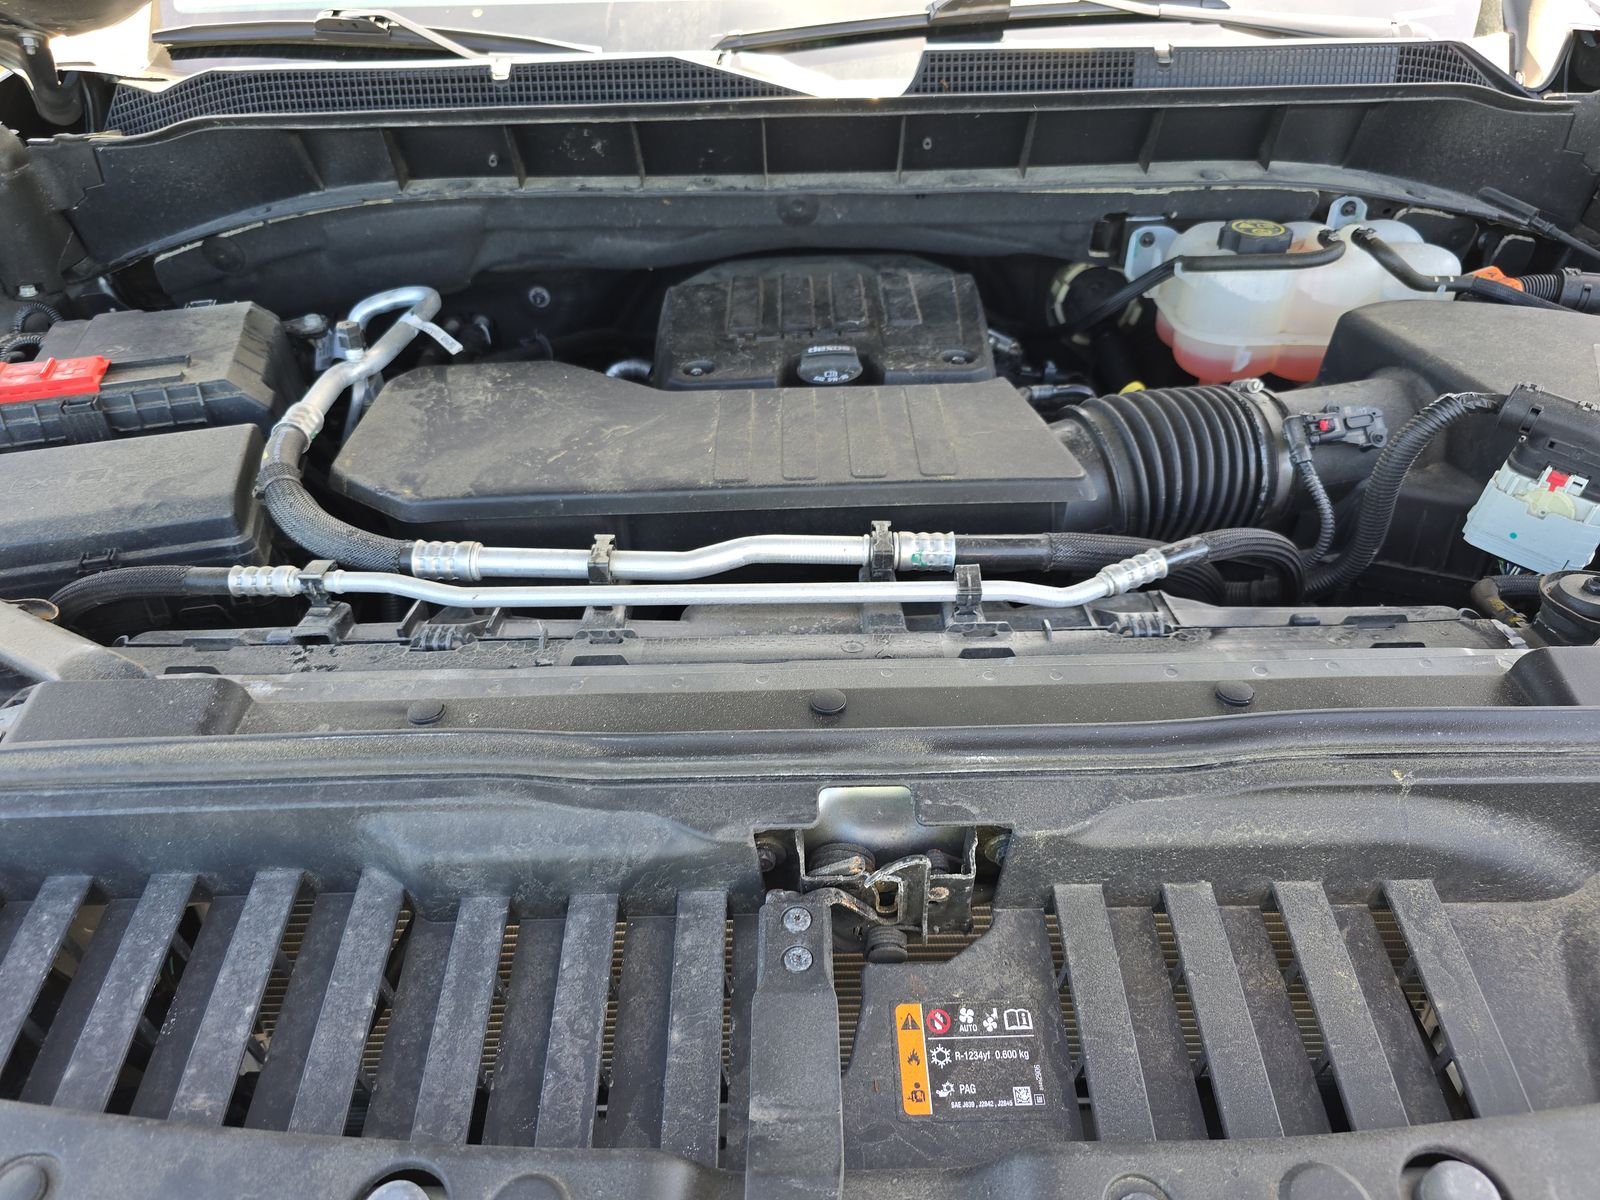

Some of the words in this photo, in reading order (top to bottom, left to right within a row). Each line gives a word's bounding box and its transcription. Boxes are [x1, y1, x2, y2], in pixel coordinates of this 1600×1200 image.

[960, 1024, 978, 1032] AUTO
[995, 1050, 1017, 1060] 0.600
[1019, 1049, 1030, 1060] kg
[959, 1084, 976, 1094] PAG
